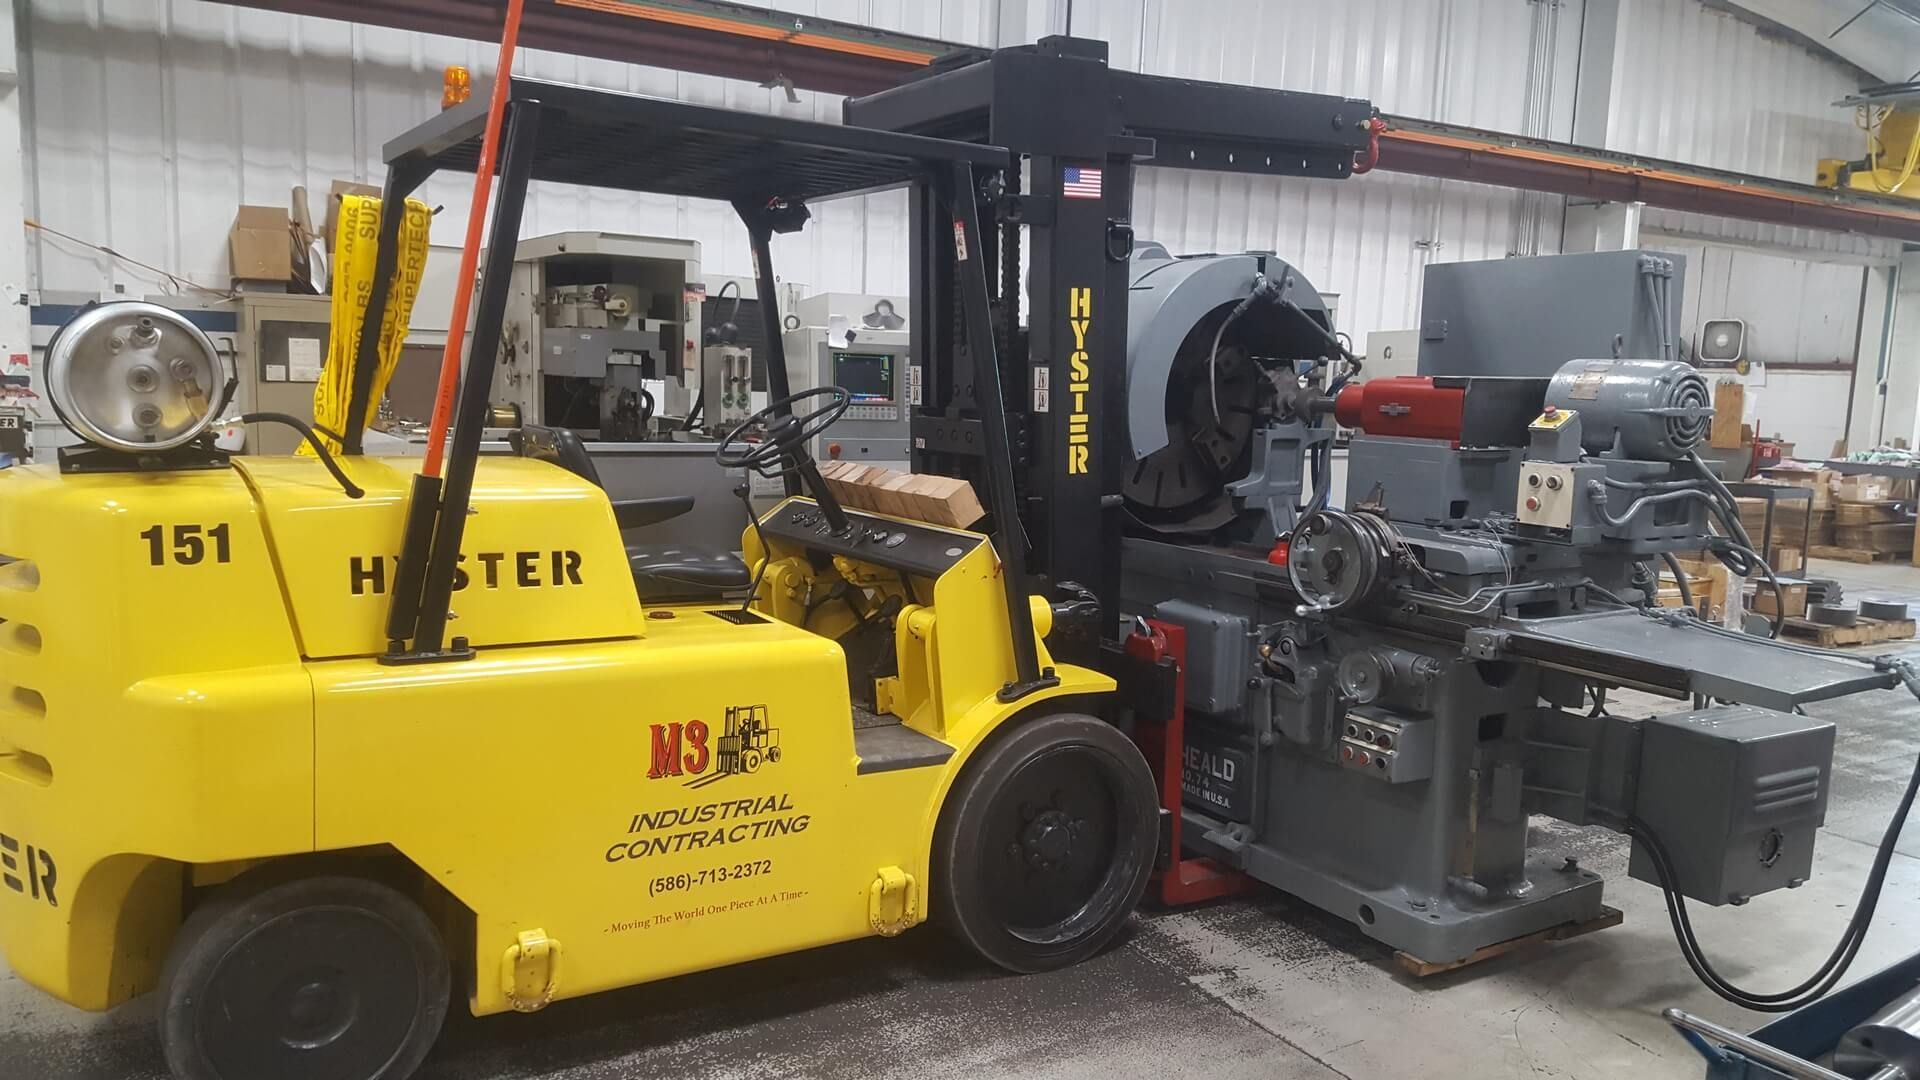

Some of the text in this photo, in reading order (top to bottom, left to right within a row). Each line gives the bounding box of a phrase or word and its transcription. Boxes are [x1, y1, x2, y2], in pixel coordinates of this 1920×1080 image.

[1069, 287, 1091, 475] HYSTER
[140, 523, 231, 566] 151
[646, 719, 709, 779] M3
[627, 793, 794, 834] INDUSTRIAL
[605, 815, 812, 863] CONTRACTING
[648, 859, 772, 898] (586)-713-2372
[611, 920, 651, 934] Moving
[652, 914, 672, 925] The
[674, 907, 705, 921] World
[707, 904, 728, 915] One
[730, 899, 754, 911] Piece
[756, 895, 768, 906] At
[770, 894, 778, 903] A
[780, 890, 803, 901] Time
